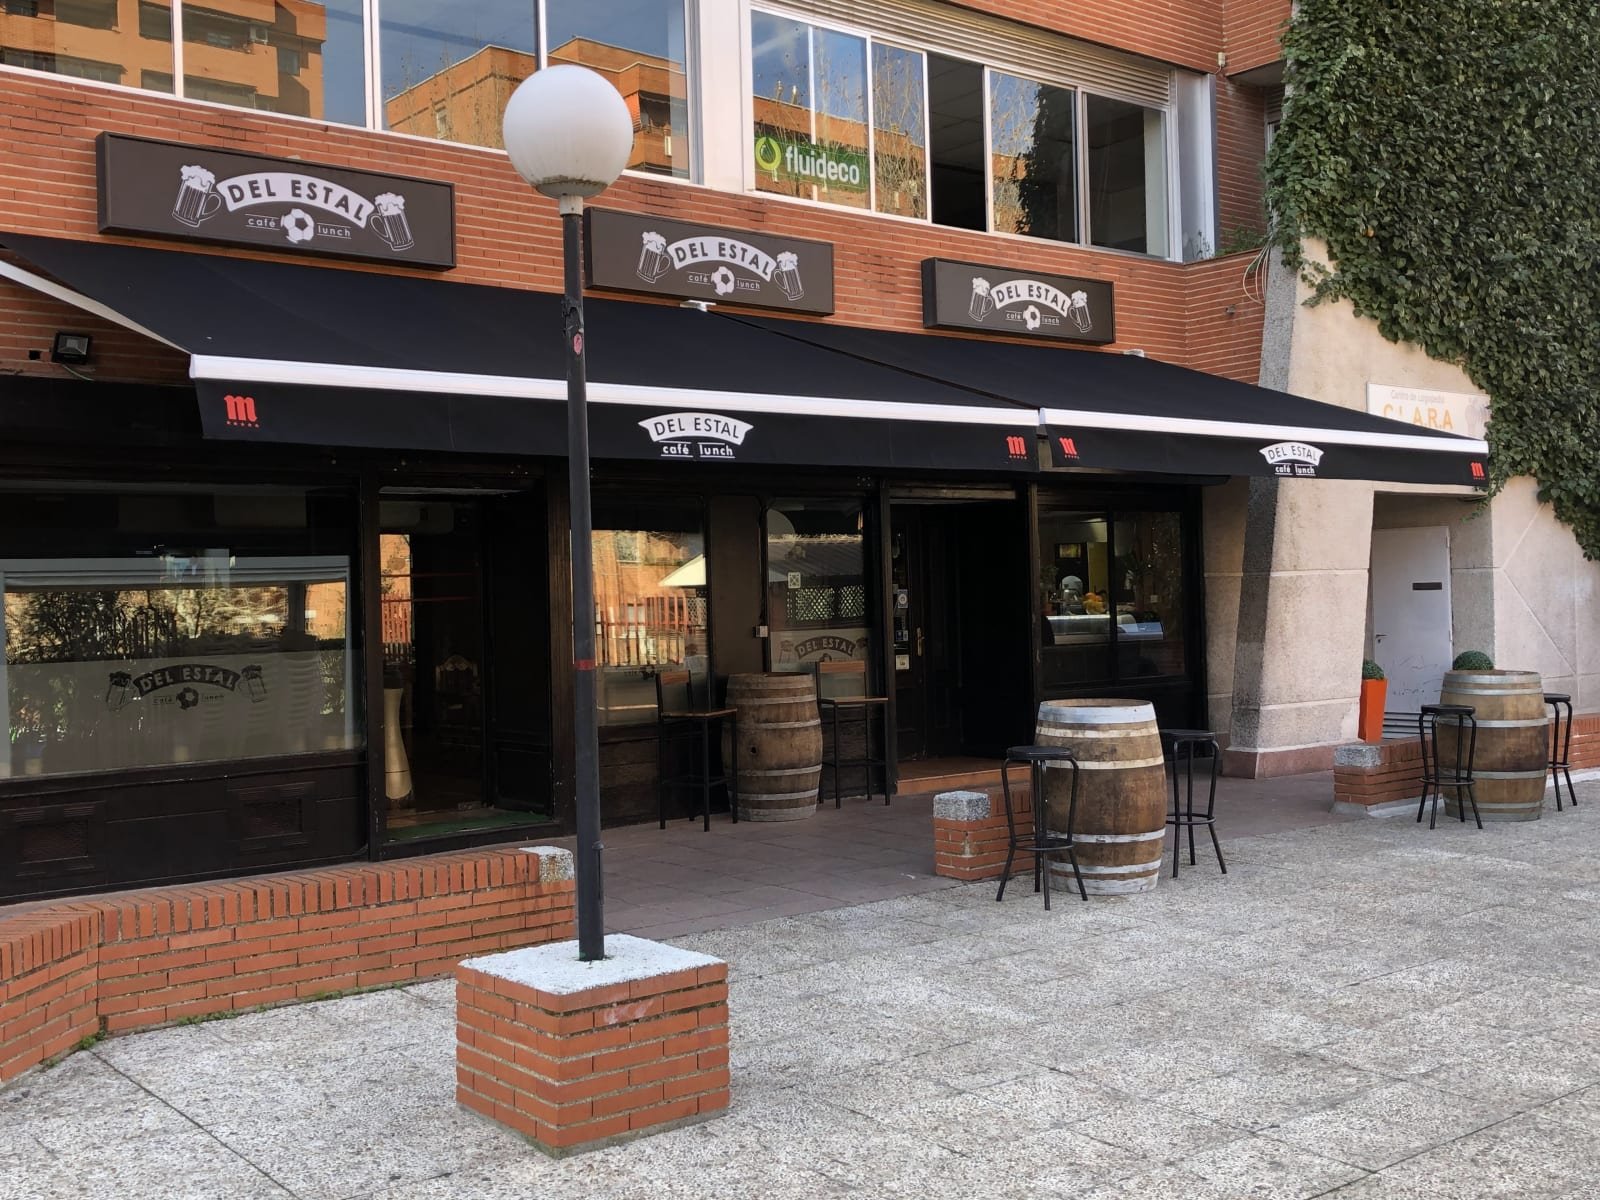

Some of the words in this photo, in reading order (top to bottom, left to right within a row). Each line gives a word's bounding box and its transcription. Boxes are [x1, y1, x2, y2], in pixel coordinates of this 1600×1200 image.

[785, 145, 860, 185] fluideco
[228, 178, 276, 203] DEL
[290, 179, 365, 222] ESTAL
[247, 216, 276, 229] café
[317, 225, 351, 237] lunch
[675, 242, 708, 262] DEL
[718, 242, 769, 275] ESTAL
[688, 273, 708, 283] café
[736, 280, 761, 289] lunch
[995, 284, 1020, 303] DEL
[1028, 284, 1066, 312] ESTAL
[654, 417, 685, 436] DEL
[694, 417, 739, 439] ESTAL
[662, 443, 689, 455] café
[698, 443, 733, 456] lunch
[1267, 447, 1288, 460] DEL
[1291, 445, 1317, 461] ESTAL
[1295, 464, 1315, 474] lunch
[799, 640, 818, 655] DEL
[822, 638, 853, 654] ESTAL
[140, 670, 175, 691] DEL
[183, 667, 234, 688] ESTAL
